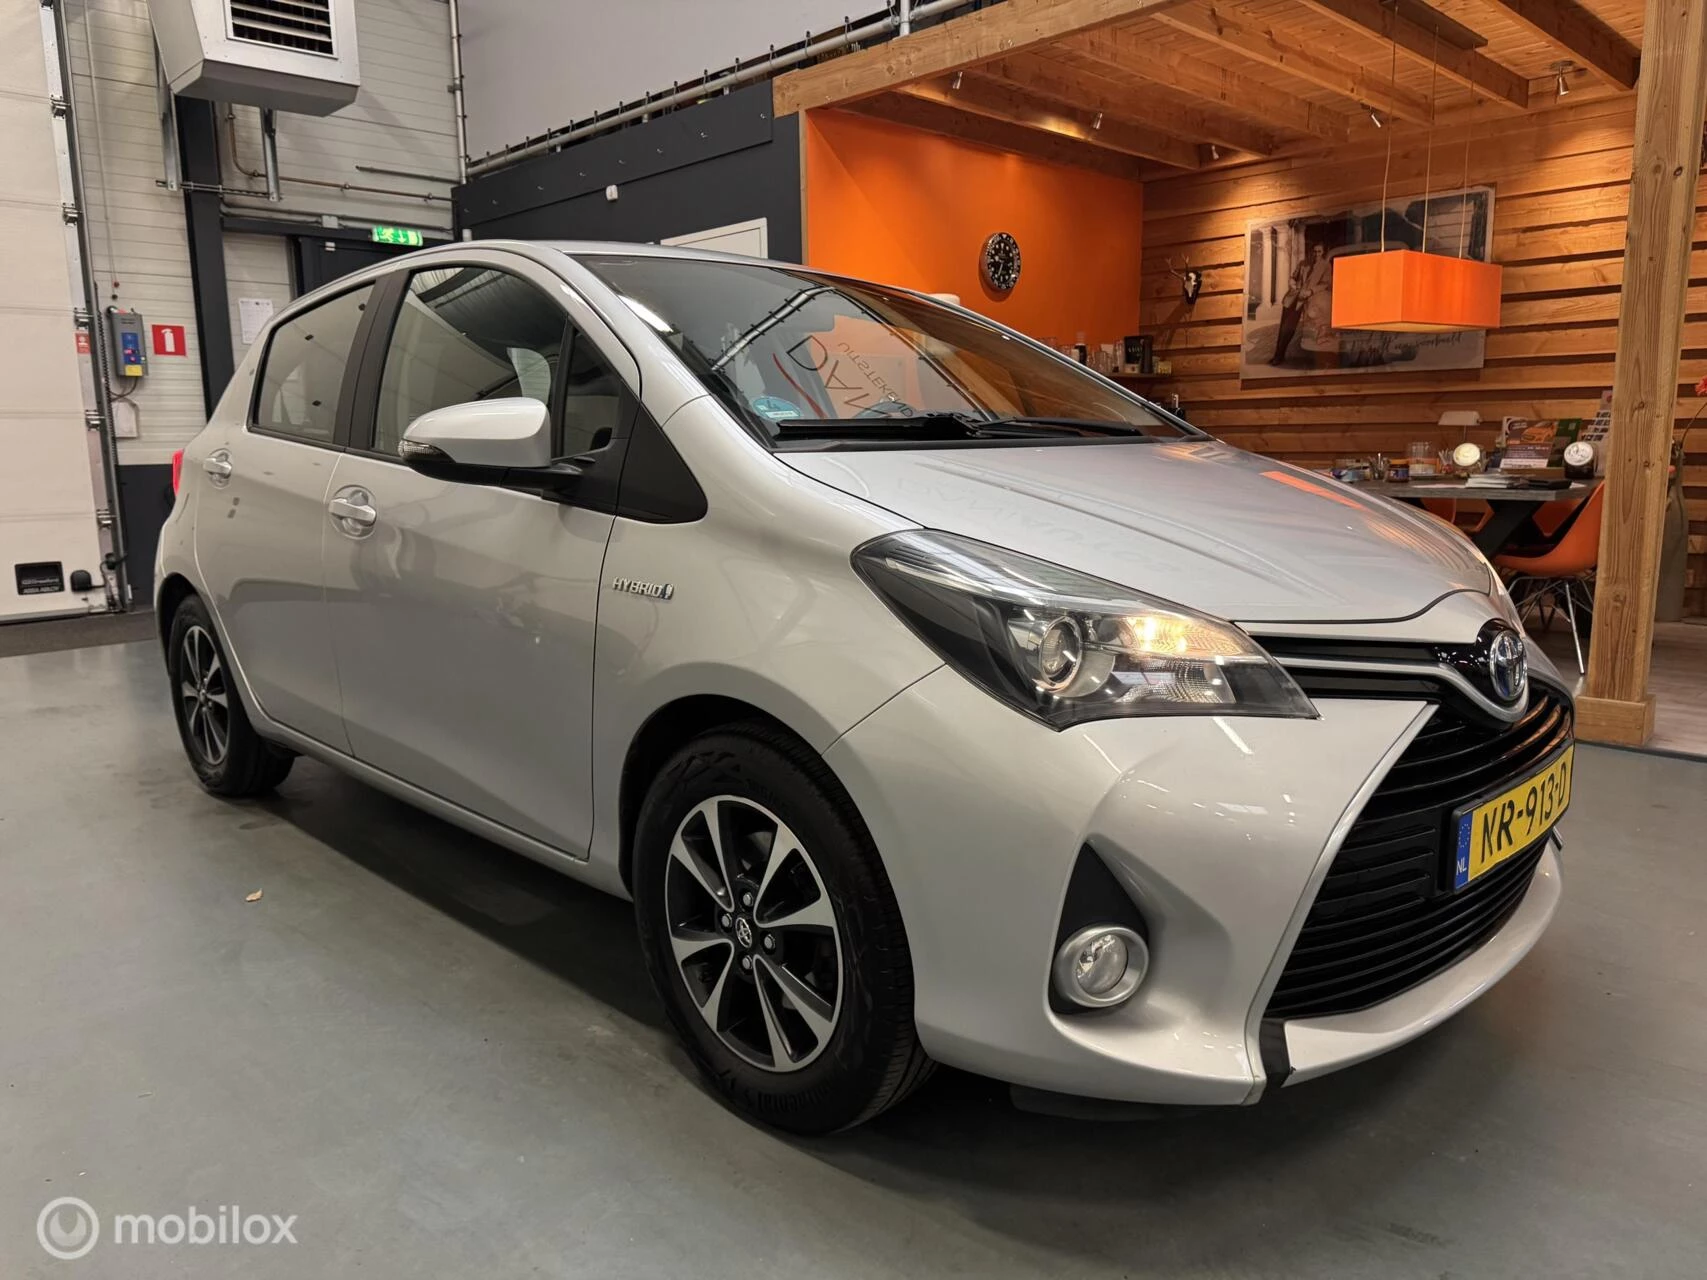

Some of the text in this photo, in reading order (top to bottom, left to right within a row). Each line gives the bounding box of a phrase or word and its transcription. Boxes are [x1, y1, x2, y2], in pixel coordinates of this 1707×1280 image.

[612, 577, 663, 598] HYBRID
[1480, 761, 1567, 864] NR-913-D
[1456, 859, 1467, 876] NL
